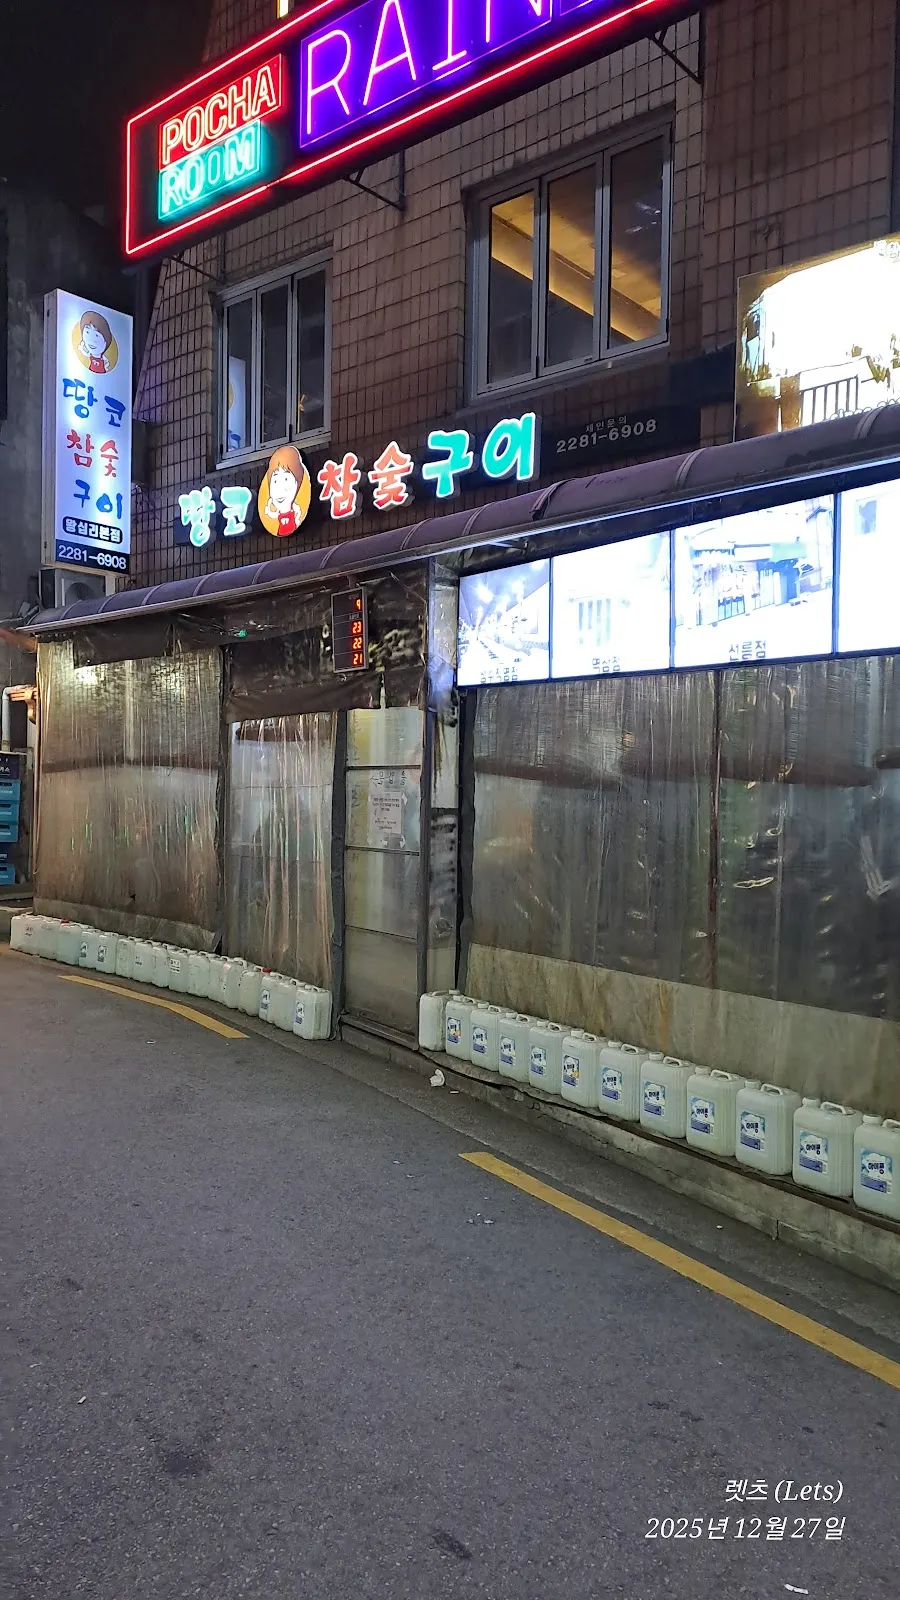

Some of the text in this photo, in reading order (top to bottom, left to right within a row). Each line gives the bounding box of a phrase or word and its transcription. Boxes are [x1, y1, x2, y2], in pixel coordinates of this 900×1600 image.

[161, 65, 277, 165] POCHA
[161, 126, 256, 213] ROOM
[62, 378, 126, 427] 땅코
[556, 419, 657, 453] 2281-6908
[66, 429, 119, 478] 참숯
[73, 479, 123, 520] 구이
[58, 545, 126, 570] 2281-6908
[356, 599, 361, 610] 9
[352, 621, 362, 633] 23
[352, 637, 362, 649] 22
[729, 640, 766, 661] 선릉점
[353, 653, 363, 665] 21
